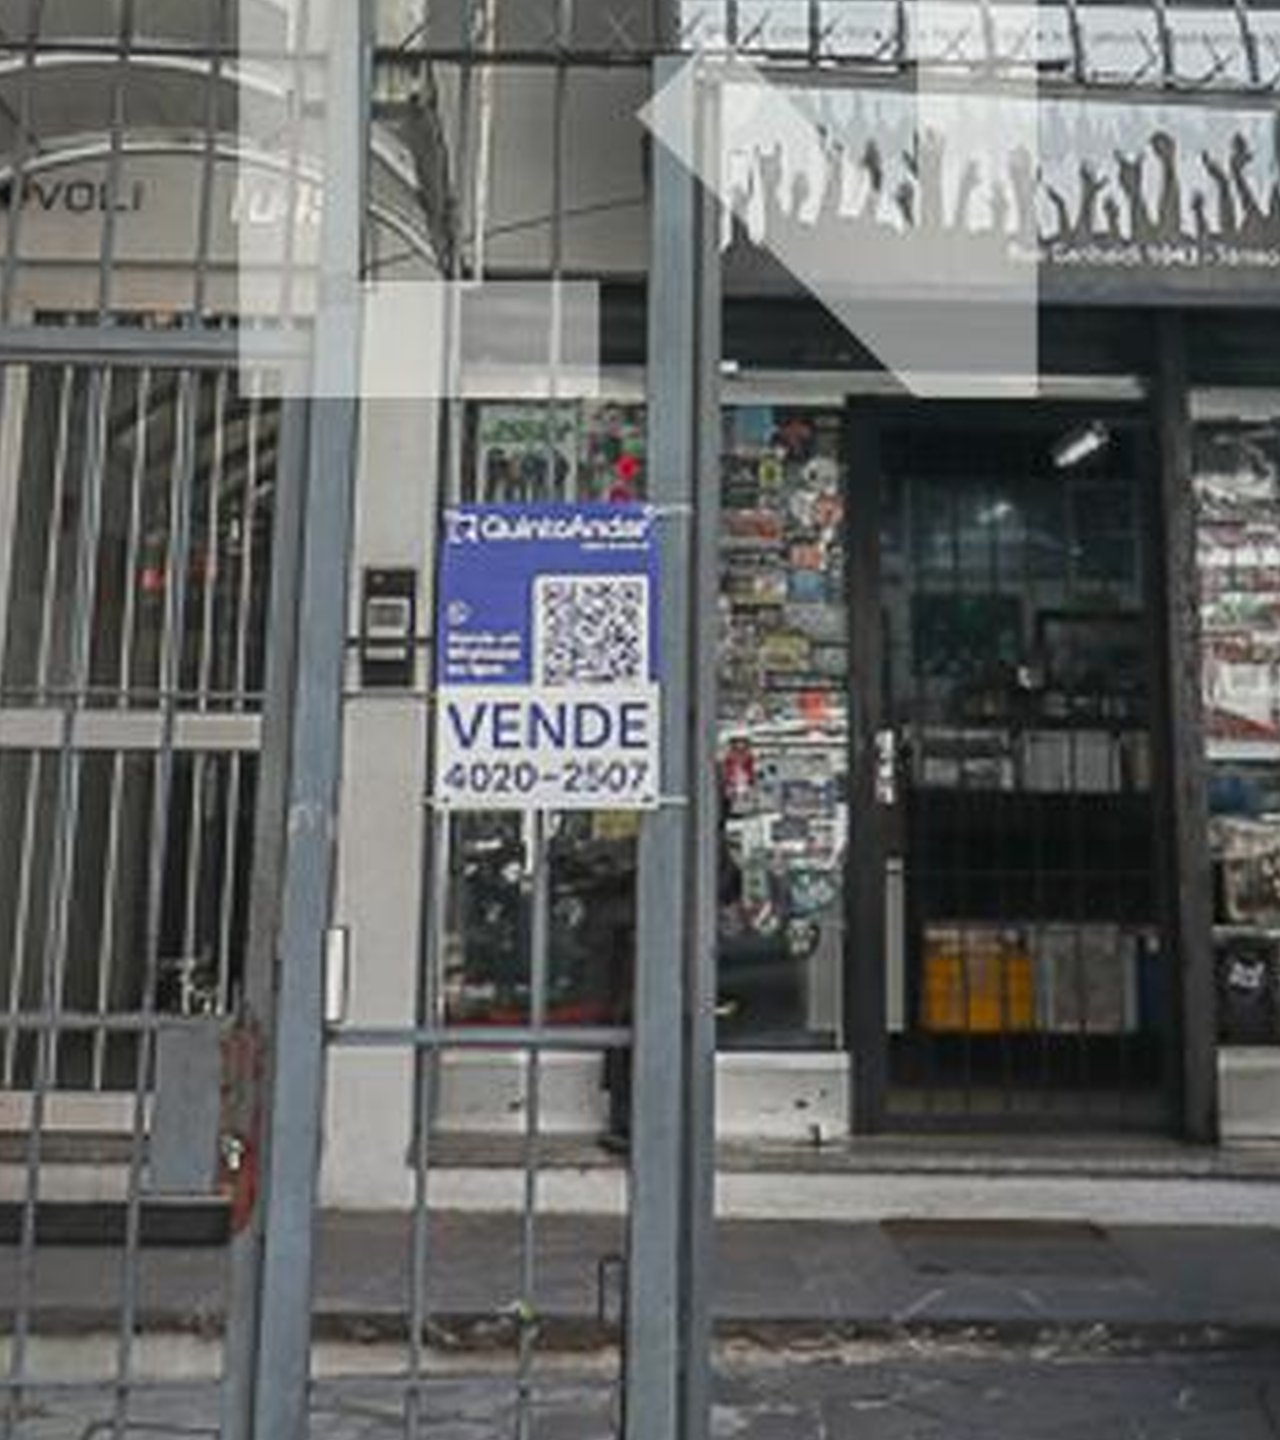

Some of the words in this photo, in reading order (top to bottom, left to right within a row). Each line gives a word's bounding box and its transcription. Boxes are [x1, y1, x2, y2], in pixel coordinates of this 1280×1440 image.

[482, 513, 649, 540] QuintoAndar
[447, 702, 649, 749] VENDE
[444, 761, 649, 793] 4020-2507
